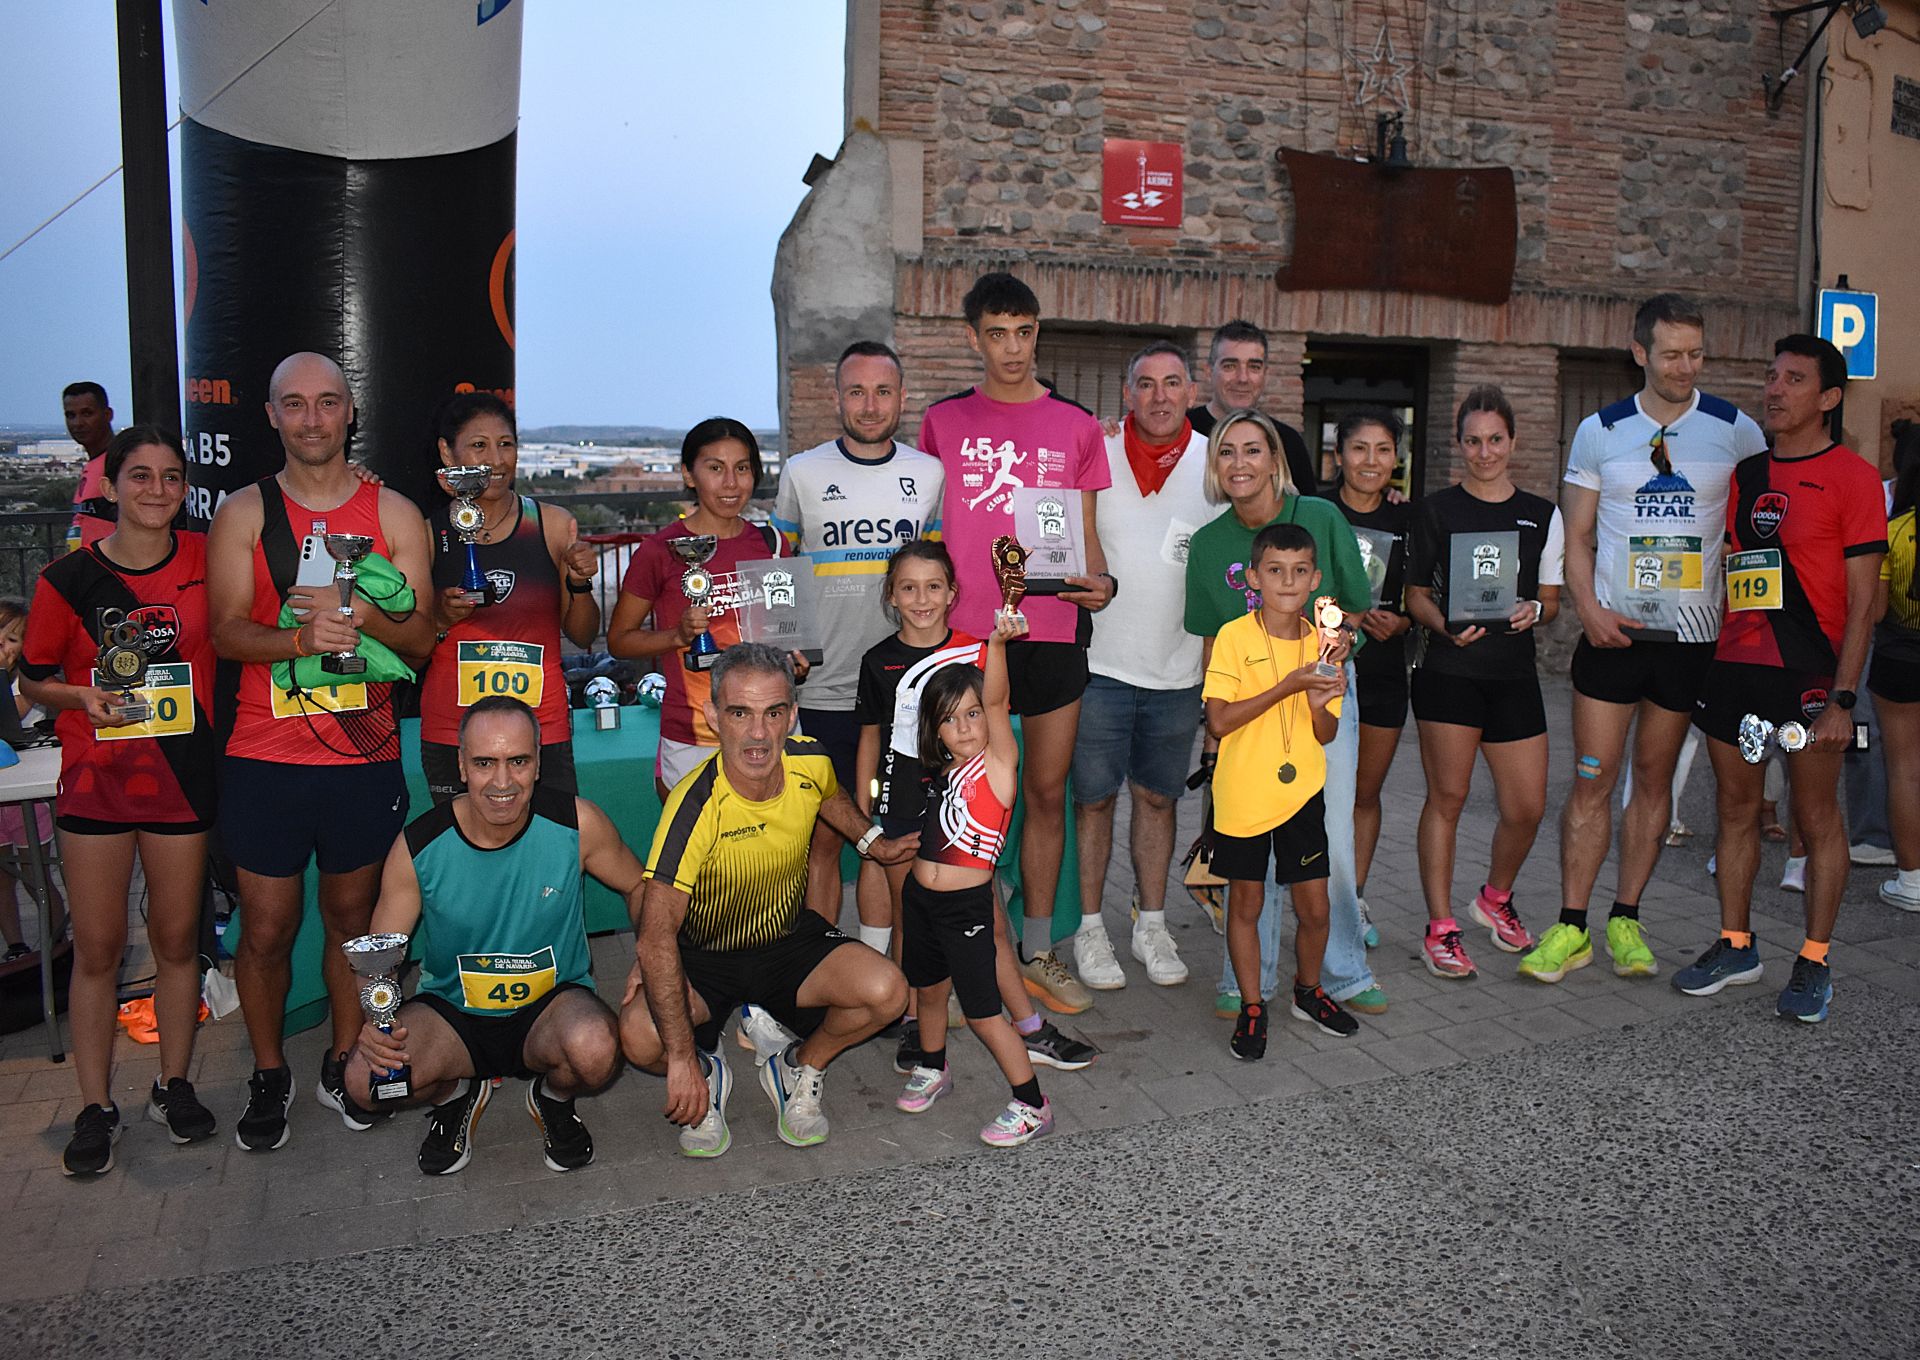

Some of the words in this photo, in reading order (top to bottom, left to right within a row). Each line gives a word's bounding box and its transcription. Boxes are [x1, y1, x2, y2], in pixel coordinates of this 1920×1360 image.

[1833, 303, 1865, 354] P
[199, 432, 232, 467] B5
[960, 437, 994, 461] 45
[1634, 495, 1695, 505] GALAR
[1634, 505, 1696, 518] TRAIL
[1753, 512, 1780, 521] LODOSA
[1050, 551, 1067, 563] RUN
[1666, 560, 1683, 579] 5
[1481, 590, 1499, 602] RUN
[1733, 577, 1768, 600] 119
[1641, 602, 1660, 613] RUN
[779, 620, 798, 634] RUN
[473, 671, 530, 695] 100
[879, 781, 890, 814] San
[720, 826, 757, 839] PROPÓSITO
[971, 833, 981, 857] club
[487, 982, 530, 1003] 49
